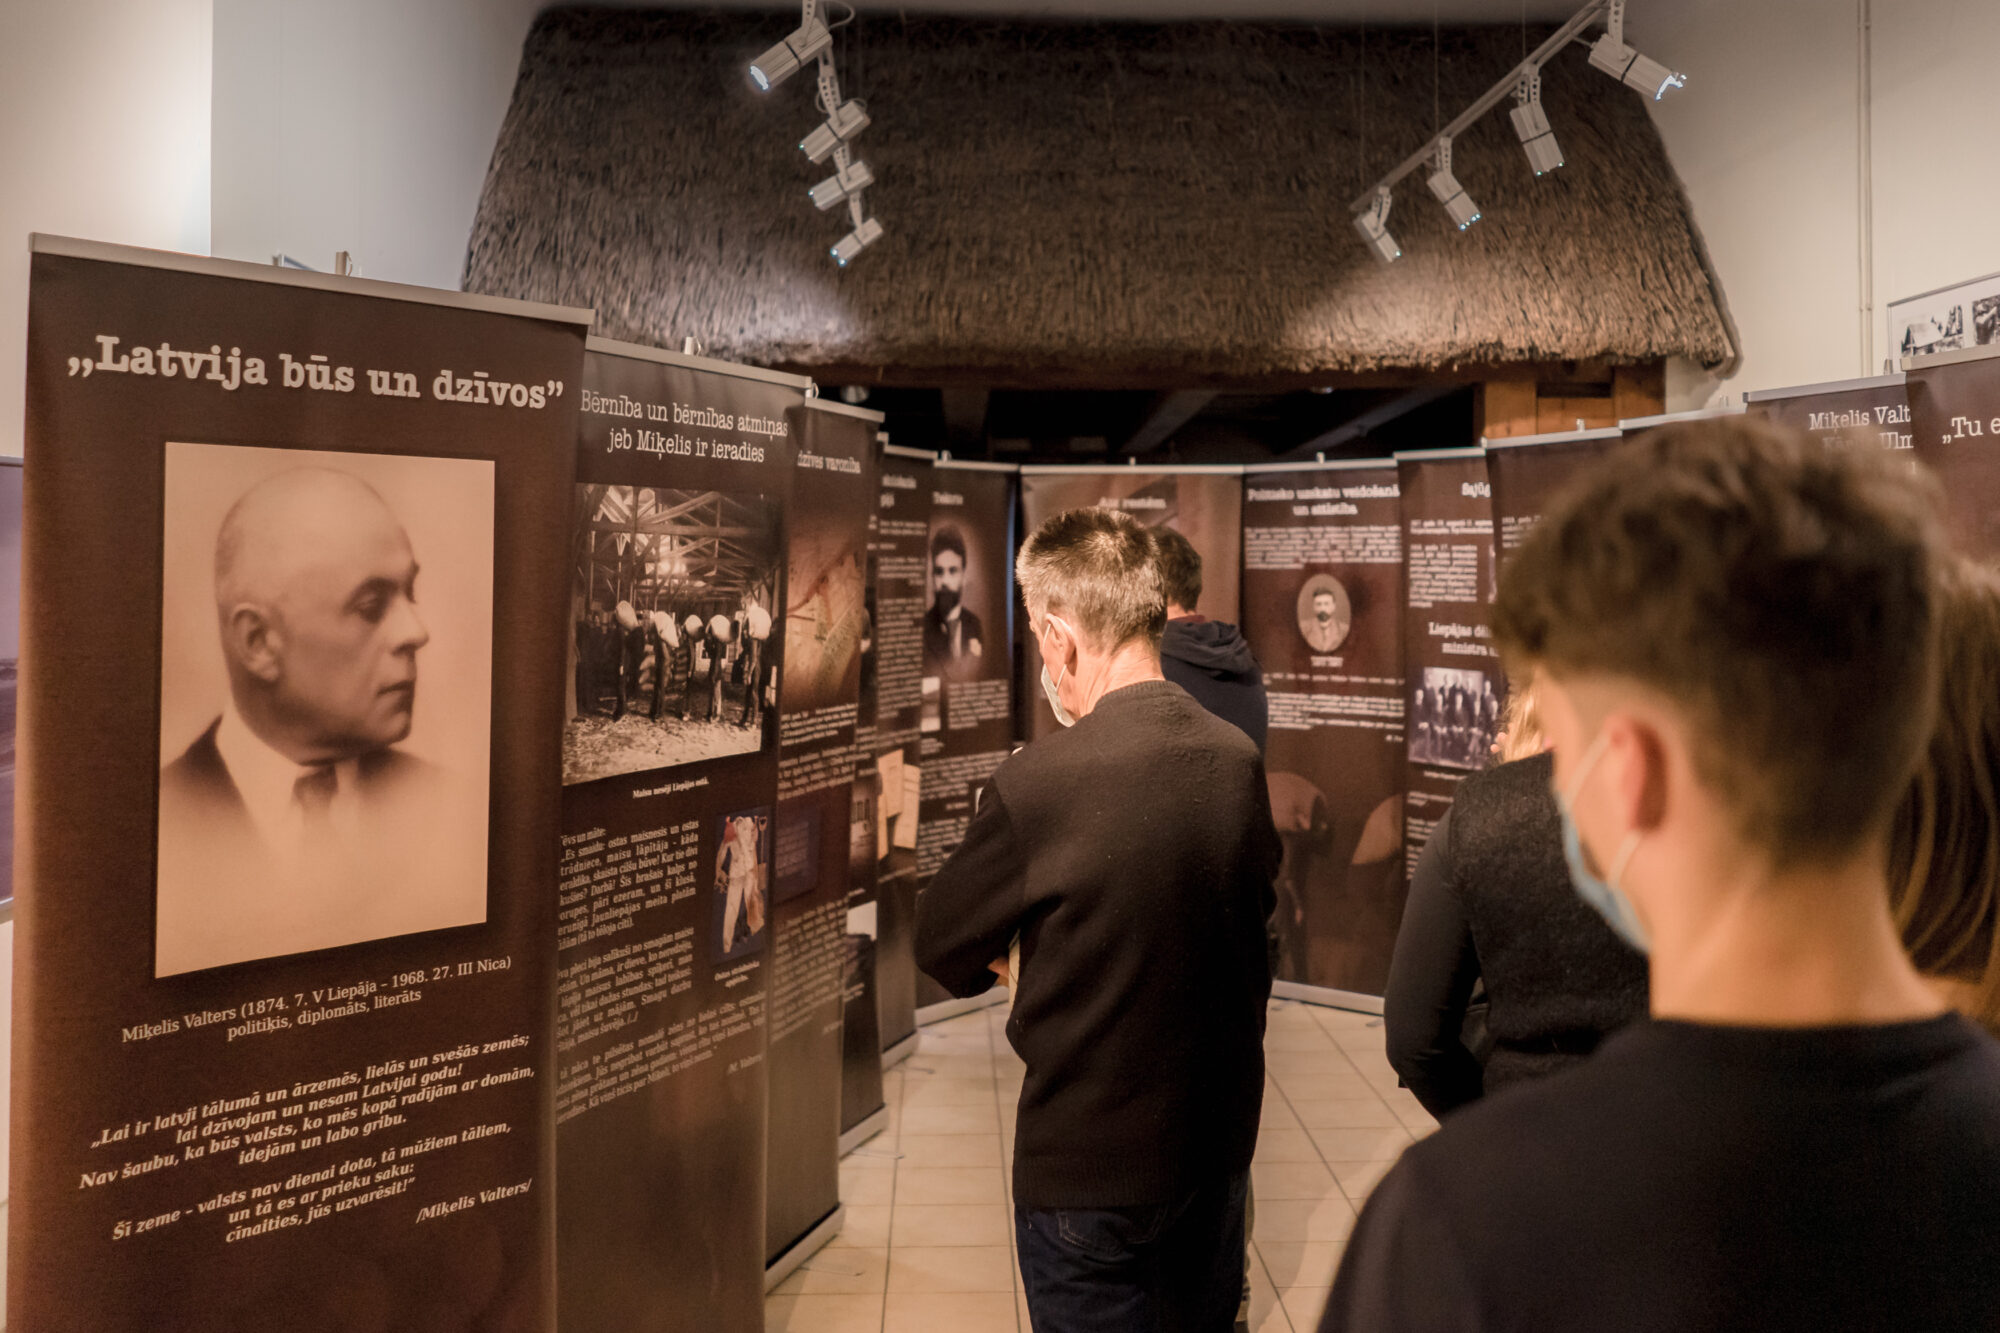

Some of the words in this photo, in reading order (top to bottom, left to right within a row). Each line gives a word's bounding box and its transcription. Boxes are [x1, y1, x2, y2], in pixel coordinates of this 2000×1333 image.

[68, 335, 268, 391] „Latvija
[280, 353, 355, 393] būs
[367, 368, 421, 398] un
[432, 370, 563, 409] dzīvos”
[580, 389, 643, 418] Bērnība
[647, 403, 668, 422] un
[673, 402, 734, 430] bērnības
[737, 415, 788, 441] atmiņas
[1874, 405, 1911, 425] Valt
[1942, 416, 1984, 444] „Tu
[1990, 418, 2000, 434] e
[607, 428, 632, 453] jeb
[636, 429, 692, 460] Miķelis
[695, 438, 708, 456] ir
[711, 438, 765, 463] ieradies
[561, 858, 602, 876] trādniece,
[122, 1020, 179, 1042] Miķelis
[184, 1009, 236, 1028] Valters
[241, 997, 289, 1019] (1874.
[294, 994, 307, 1007] 7.
[312, 990, 324, 1003] V
[328, 981, 376, 1004] Liepāja
[392, 970, 429, 989] 1968.
[433, 966, 453, 980] 27.
[458, 962, 472, 976] III
[477, 956, 511, 972] Nica)
[228, 1016, 292, 1041] politiķis,
[298, 1002, 369, 1025] diplomāts,
[374, 990, 421, 1008] literāts
[90, 1124, 130, 1148] „Lai
[135, 1121, 151, 1136] ir
[154, 1106, 197, 1128] latvji
[202, 1092, 260, 1114] tālumā
[266, 1090, 287, 1102] un
[292, 1072, 361, 1096] ārzemēs,
[365, 1060, 405, 1081] lielās
[410, 1057, 428, 1068] un
[432, 1044, 478, 1064] svešās
[482, 1034, 529, 1053] zemēs;
[176, 1126, 197, 1143] lai
[202, 1110, 276, 1136] dzīvojam
[282, 1104, 302, 1117] un
[309, 1091, 357, 1111] nesam
[363, 1073, 416, 1095] Latvijai
[421, 1064, 462, 1087] godu!
[79, 1170, 118, 1188] Nav
[122, 1155, 178, 1178] šaubu,
[185, 1146, 204, 1160] ka
[210, 1136, 240, 1153] būs
[245, 1124, 297, 1145] valsts,
[303, 1118, 322, 1131] ko
[328, 1108, 357, 1125] mēs
[362, 1095, 396, 1115] kopā
[402, 1084, 457, 1105] radījām
[462, 1080, 478, 1091] ar
[480, 1068, 534, 1087] domām,
[239, 1142, 295, 1164] idejām
[302, 1136, 321, 1149] un
[326, 1126, 358, 1143] labo
[363, 1114, 406, 1136] gribu.
[112, 1221, 132, 1240] Šī
[136, 1210, 180, 1232] zeme
[198, 1191, 246, 1213] valsts
[252, 1183, 281, 1199] nav
[286, 1165, 335, 1190] dienai
[340, 1158, 376, 1174] dota,
[382, 1148, 395, 1163] tā
[401, 1135, 457, 1158] mūžiem
[462, 1123, 510, 1142] tāliem,
[229, 1209, 250, 1223] un
[256, 1200, 272, 1216] tā
[278, 1197, 295, 1210] es
[300, 1191, 318, 1204] ar
[322, 1176, 370, 1201] prieku
[375, 1164, 414, 1182] saku:
[416, 1196, 475, 1223] /Miķelis
[480, 1178, 532, 1202] Valters/
[226, 1214, 302, 1242] cīnaities,
[305, 1204, 331, 1224] jūs
